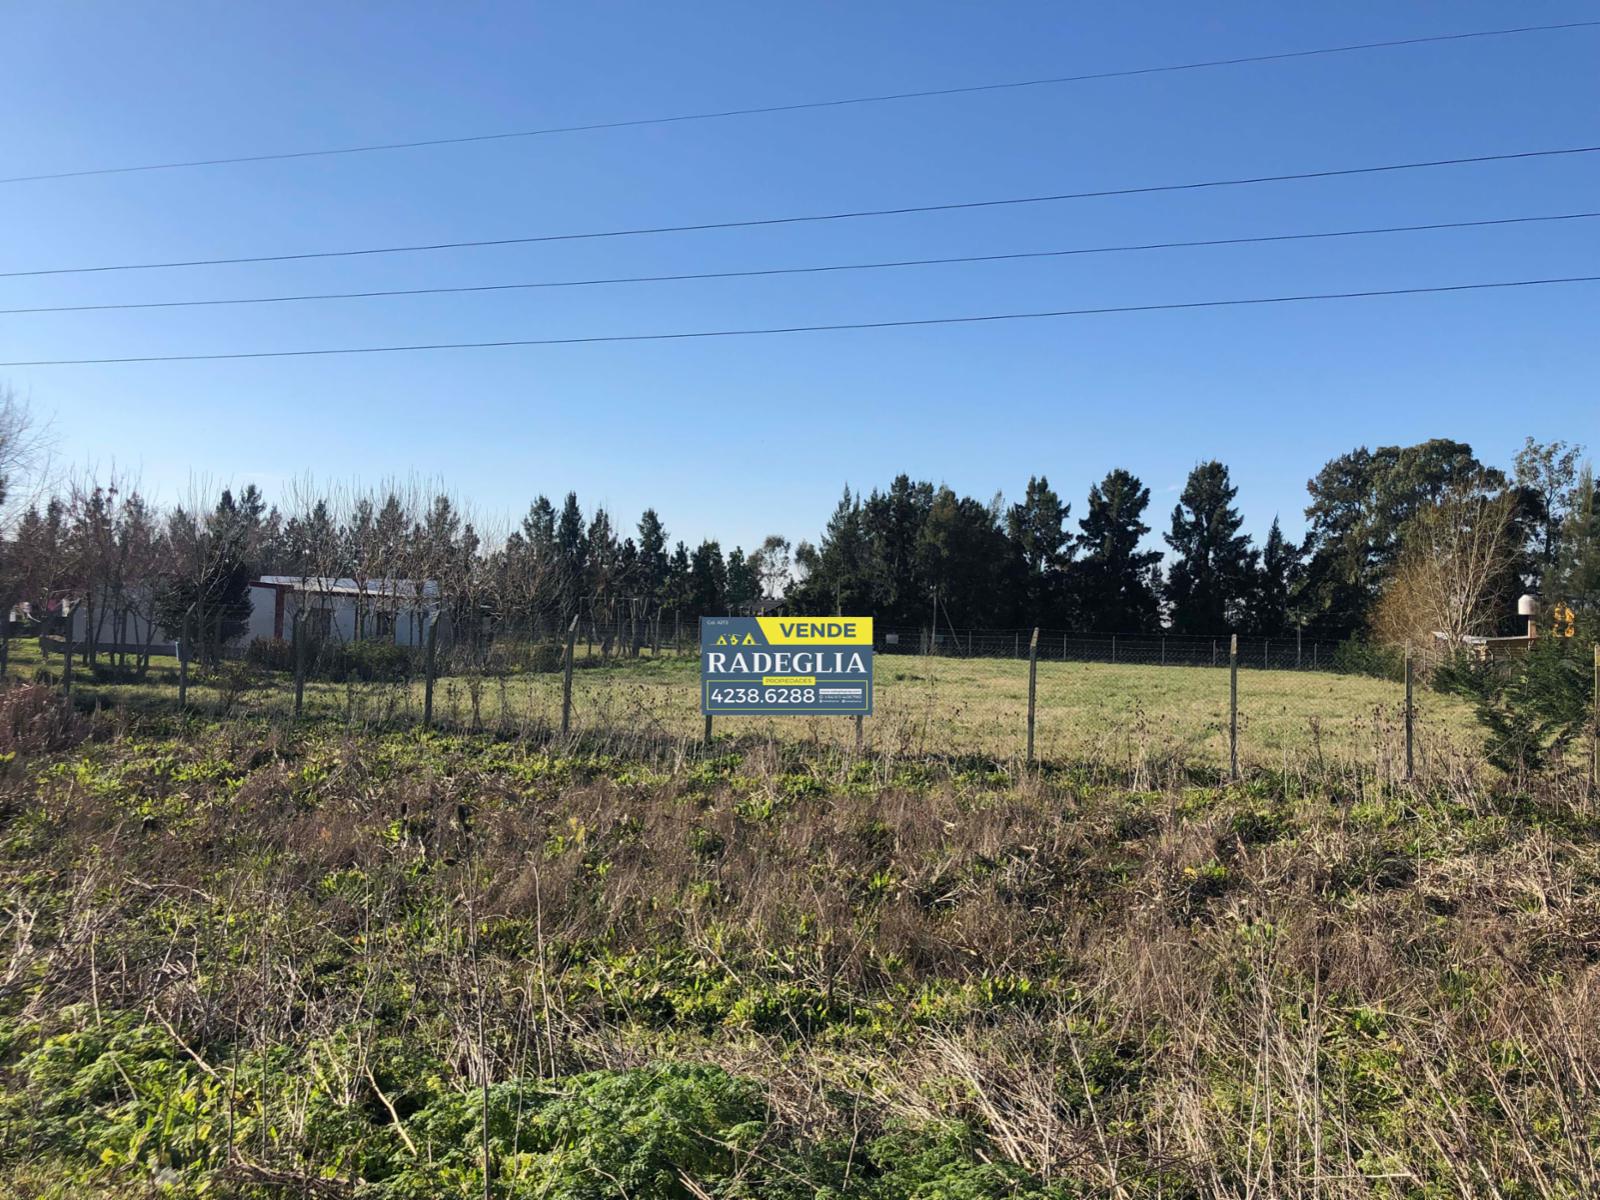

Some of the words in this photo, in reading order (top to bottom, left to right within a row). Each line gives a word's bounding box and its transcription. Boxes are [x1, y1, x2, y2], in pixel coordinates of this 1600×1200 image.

[779, 623, 857, 638] VENDE
[706, 652, 868, 673] RADEGLIA
[711, 688, 816, 703] 4238.6288
